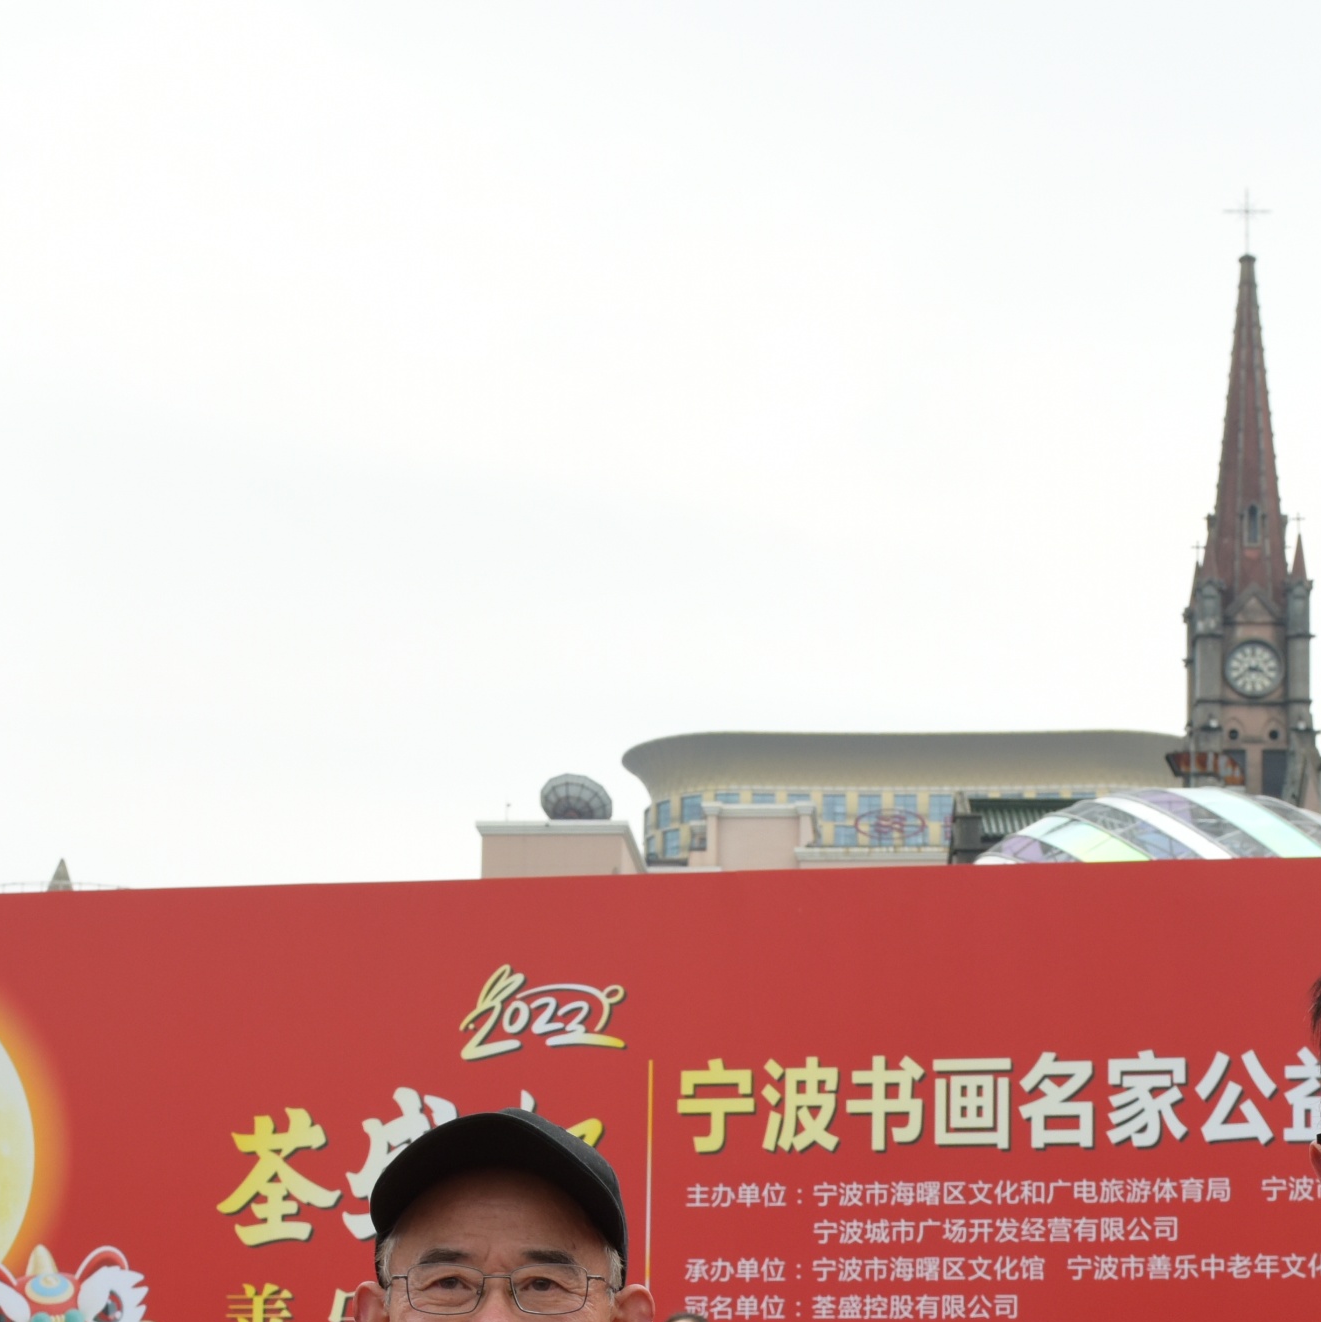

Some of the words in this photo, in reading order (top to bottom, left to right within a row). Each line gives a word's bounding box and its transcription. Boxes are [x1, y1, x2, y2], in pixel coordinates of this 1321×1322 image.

[813, 1216, 1178, 1245] 宁波城市广场开发经营有限公司
